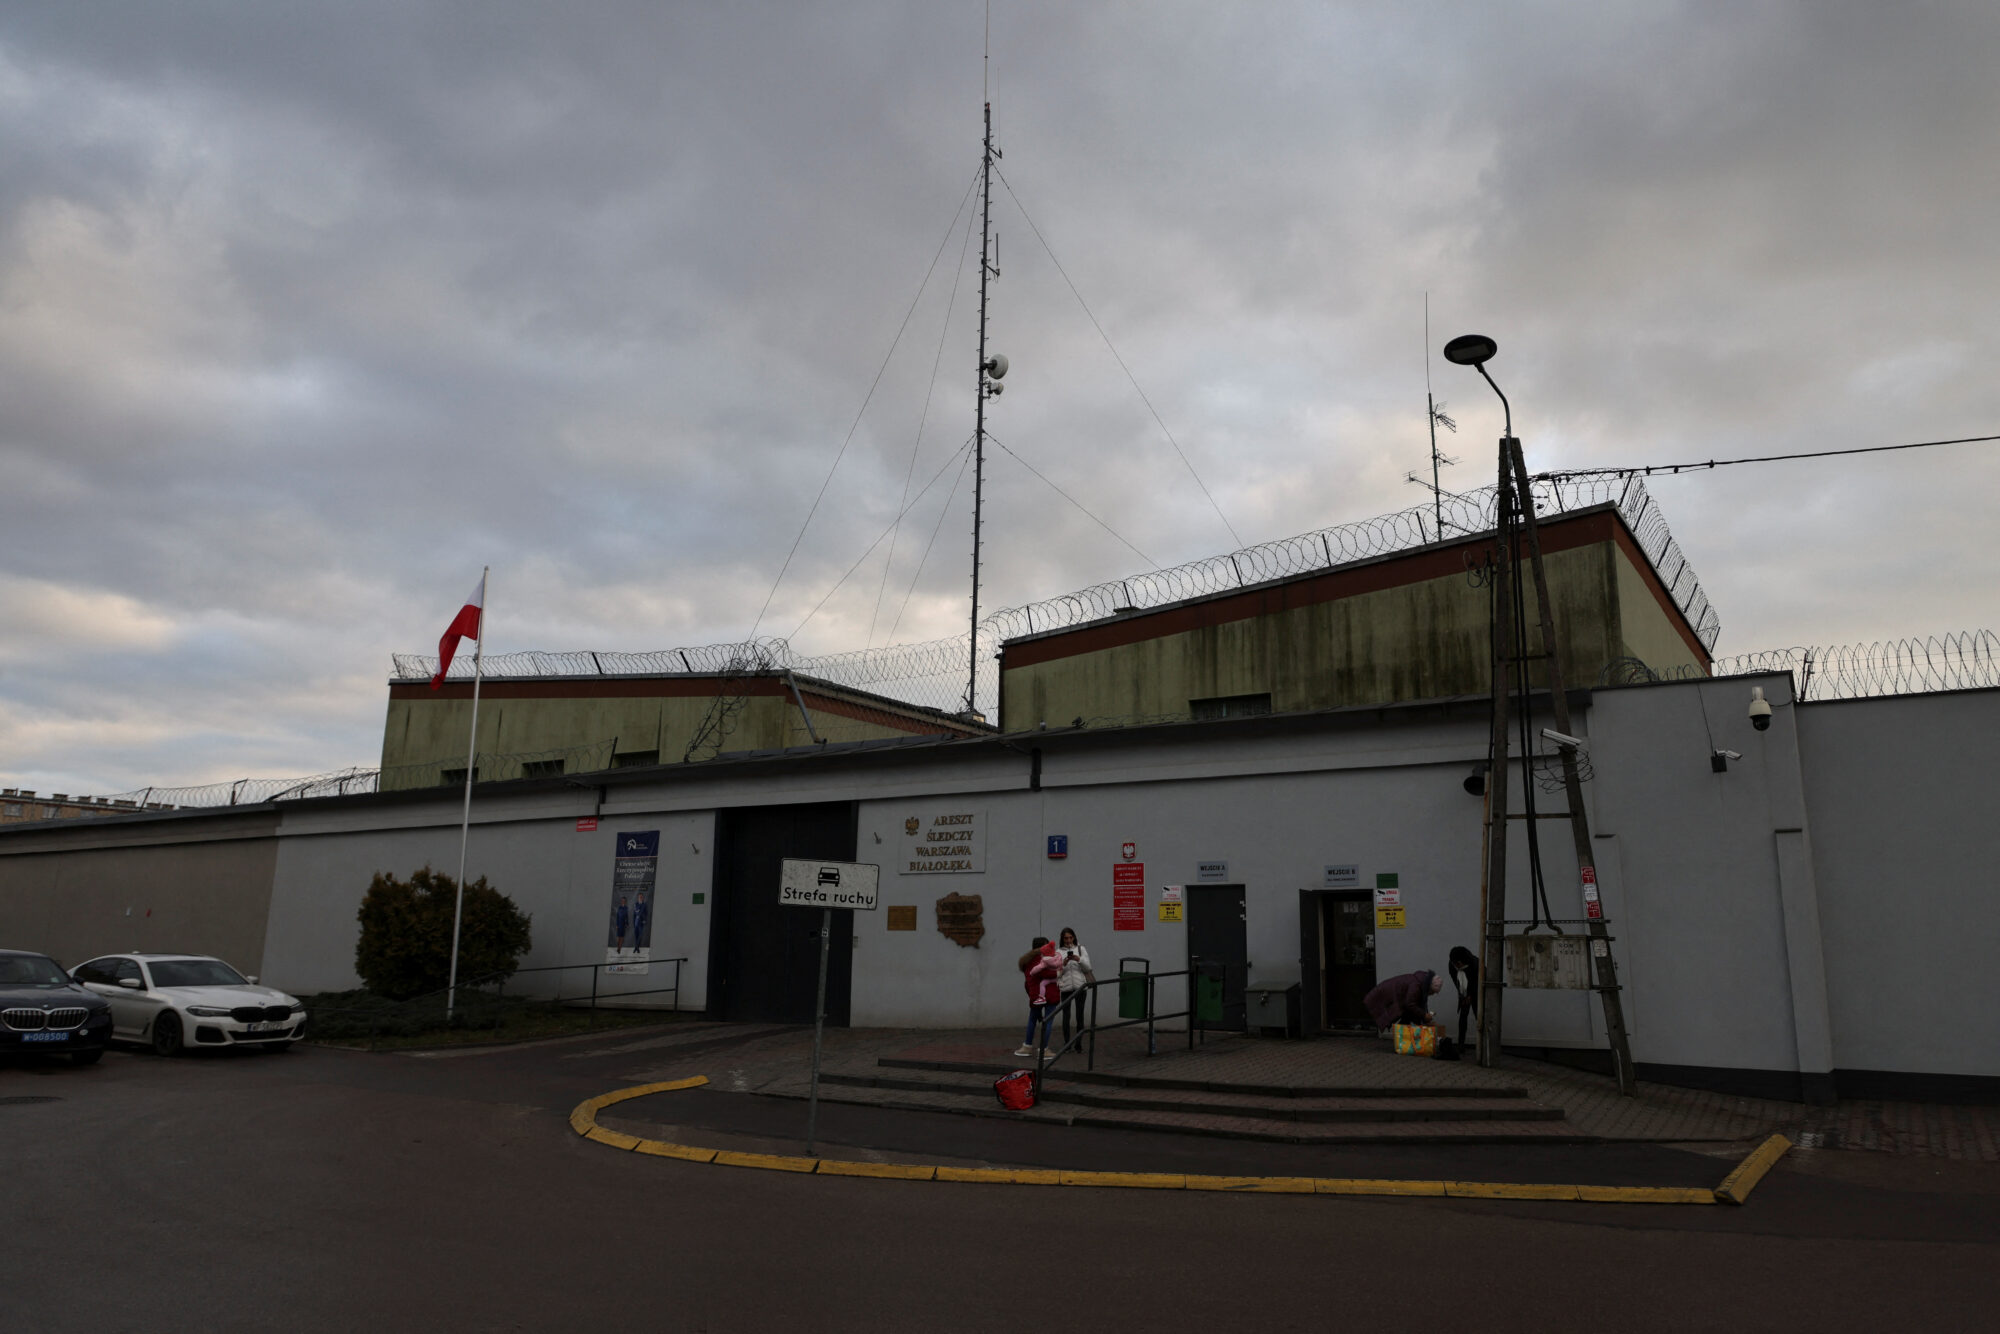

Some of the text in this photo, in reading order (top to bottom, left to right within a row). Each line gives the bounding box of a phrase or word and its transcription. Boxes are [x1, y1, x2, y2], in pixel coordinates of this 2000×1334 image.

[934, 815, 974, 826] ARESZT
[927, 829, 974, 842] ŚLEDCZY
[915, 845, 972, 857] WARSZAWA
[1053, 840, 1058, 852] 1
[909, 860, 972, 872] BIAŁOŁĘKA
[783, 887, 874, 905] Strefa ruchu
